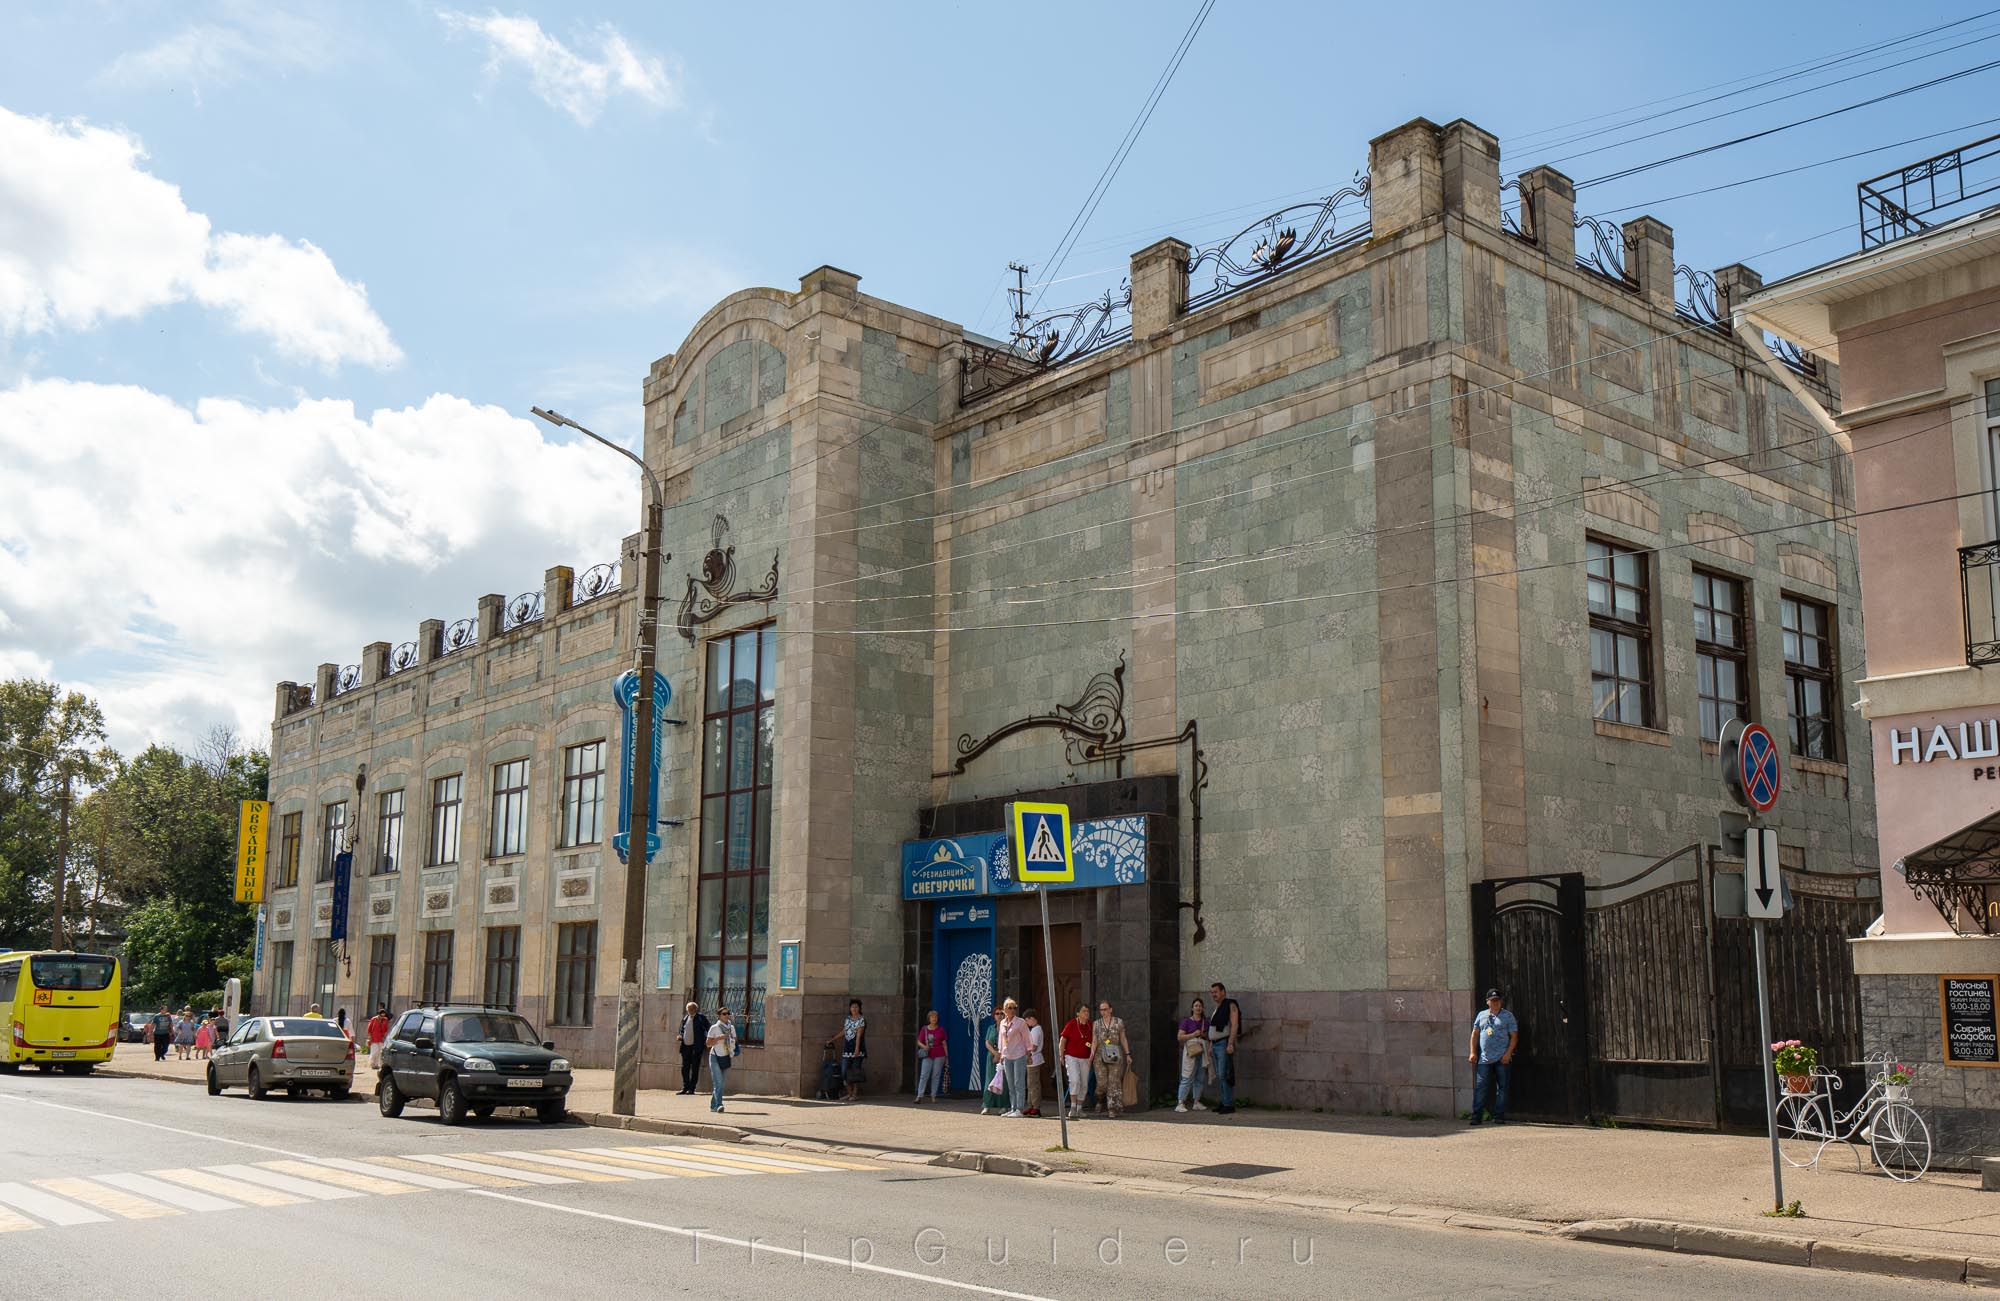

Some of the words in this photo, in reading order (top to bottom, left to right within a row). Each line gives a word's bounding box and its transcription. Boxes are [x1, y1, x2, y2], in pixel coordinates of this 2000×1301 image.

[1973, 767, 2000, 781] РЕ
[244, 803, 262, 900] ЮВЕЛИРНЫЙ
[922, 868, 964, 878] РЕЗИДЕНЦИЯ
[912, 878, 975, 895] СНЕГУРОЧКИ
[1950, 980, 1988, 990] Вкусный
[1954, 1024, 1991, 1034] Сырная
[1950, 1032, 1996, 1042] кладовка
[1953, 1047, 1994, 1055] 9.00-18.00
